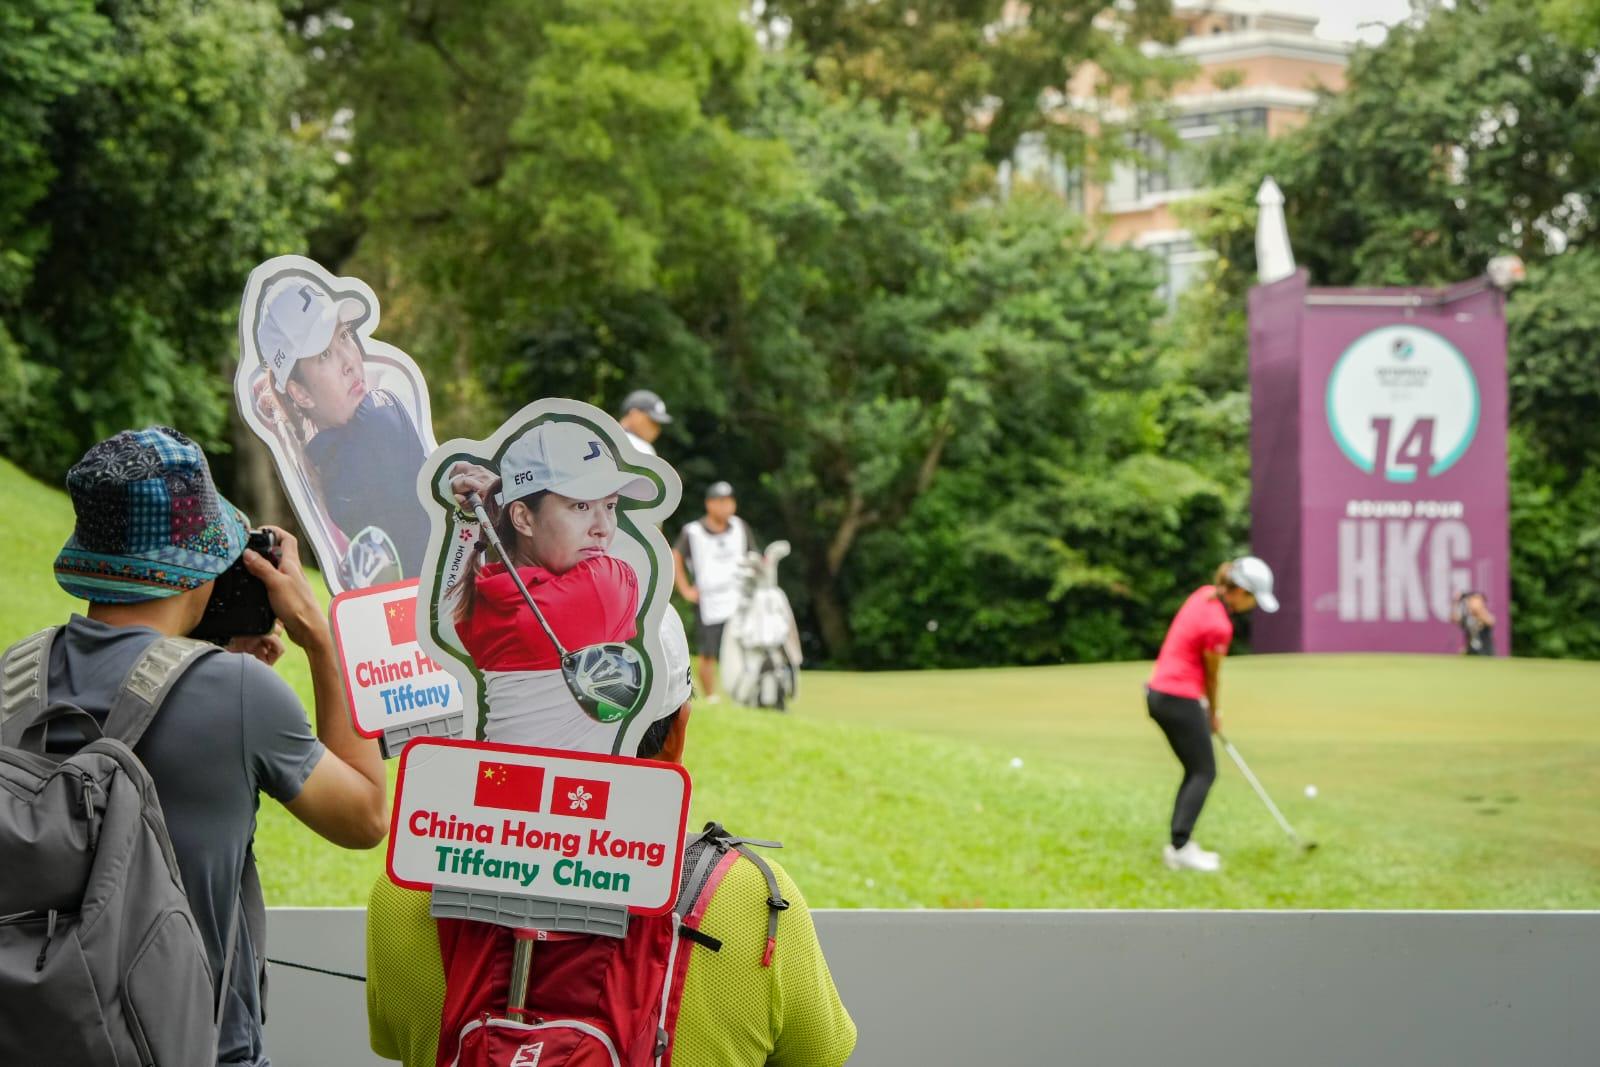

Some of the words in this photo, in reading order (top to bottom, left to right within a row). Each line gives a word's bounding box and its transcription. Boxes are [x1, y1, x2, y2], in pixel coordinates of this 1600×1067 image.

[274, 349, 286, 369] EFG
[1371, 416, 1437, 481] 14
[514, 471, 534, 486] EFG
[1346, 500, 1412, 519] ROUND
[1414, 500, 1464, 519] FOUR
[450, 545, 465, 571] HONG
[1338, 519, 1472, 622] HKG
[355, 659, 414, 688] China
[379, 683, 450, 715] Tiffany
[408, 810, 494, 845] China
[501, 820, 580, 858] Hong
[588, 829, 666, 867] Kong
[434, 845, 540, 887] Tiffany
[552, 858, 631, 892] Chan
